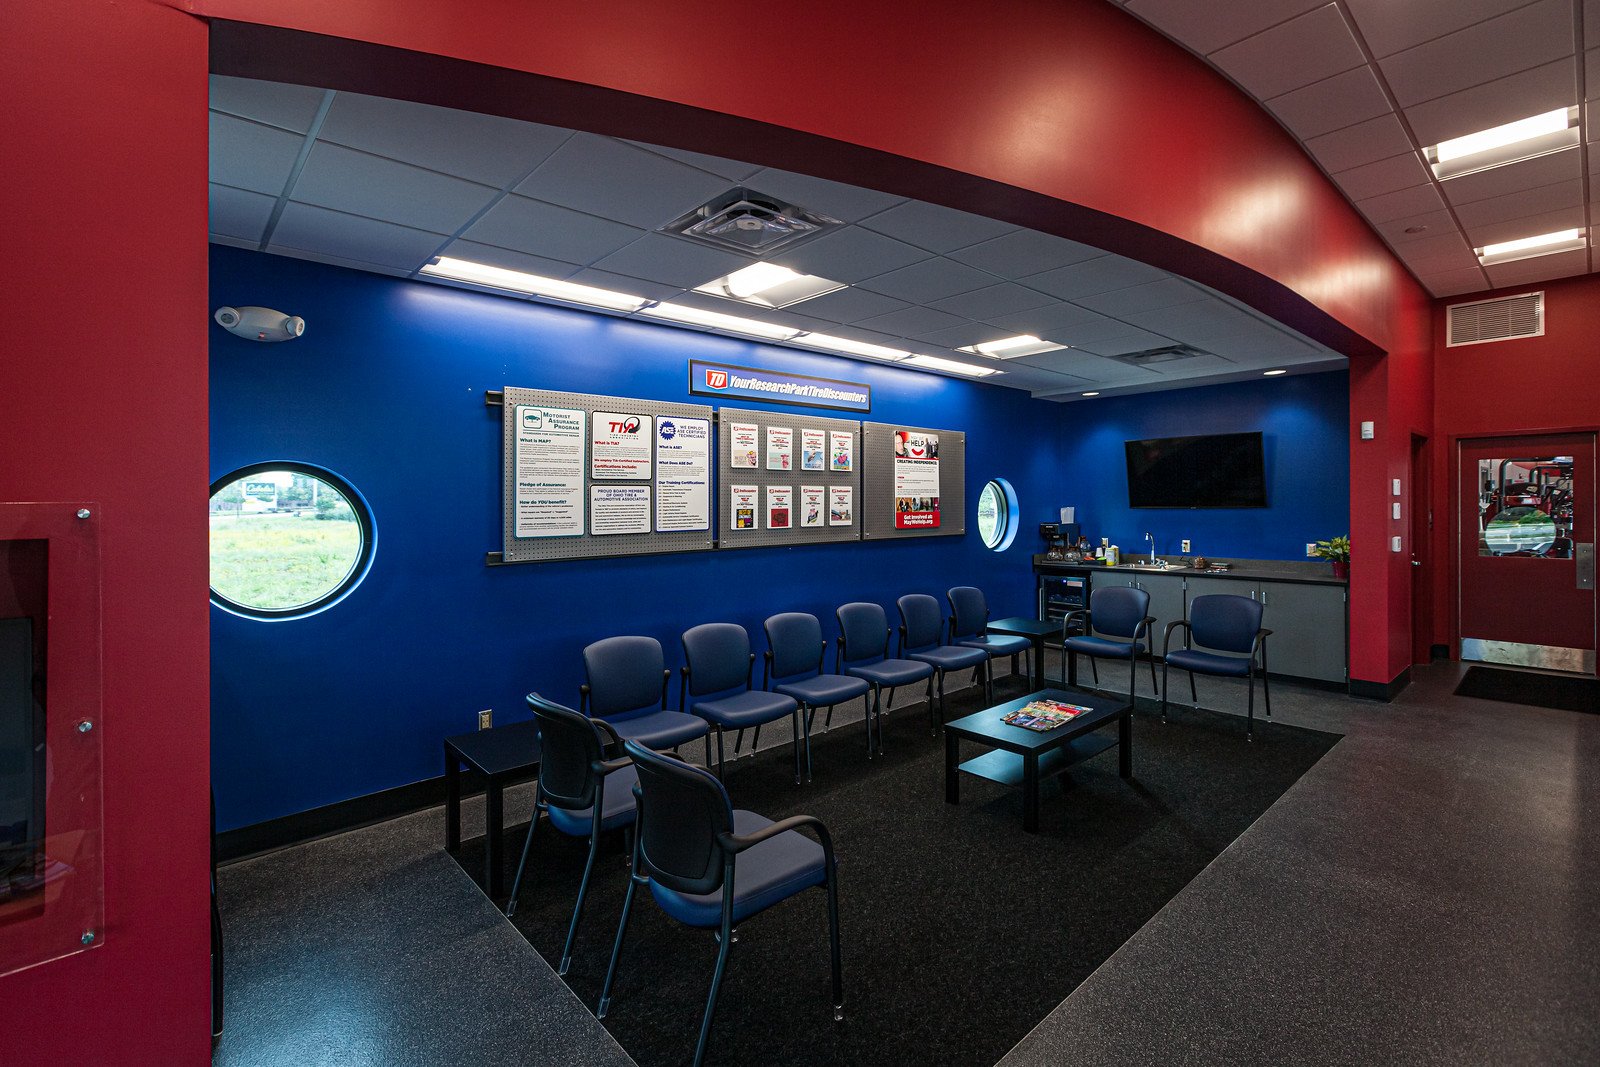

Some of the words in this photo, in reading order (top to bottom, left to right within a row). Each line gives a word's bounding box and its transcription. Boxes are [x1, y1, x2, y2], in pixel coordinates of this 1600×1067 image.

[710, 373, 725, 386] TD
[729, 375, 866, 403] YourResearchParkTireDiscounters
[609, 422, 637, 434] TIA
